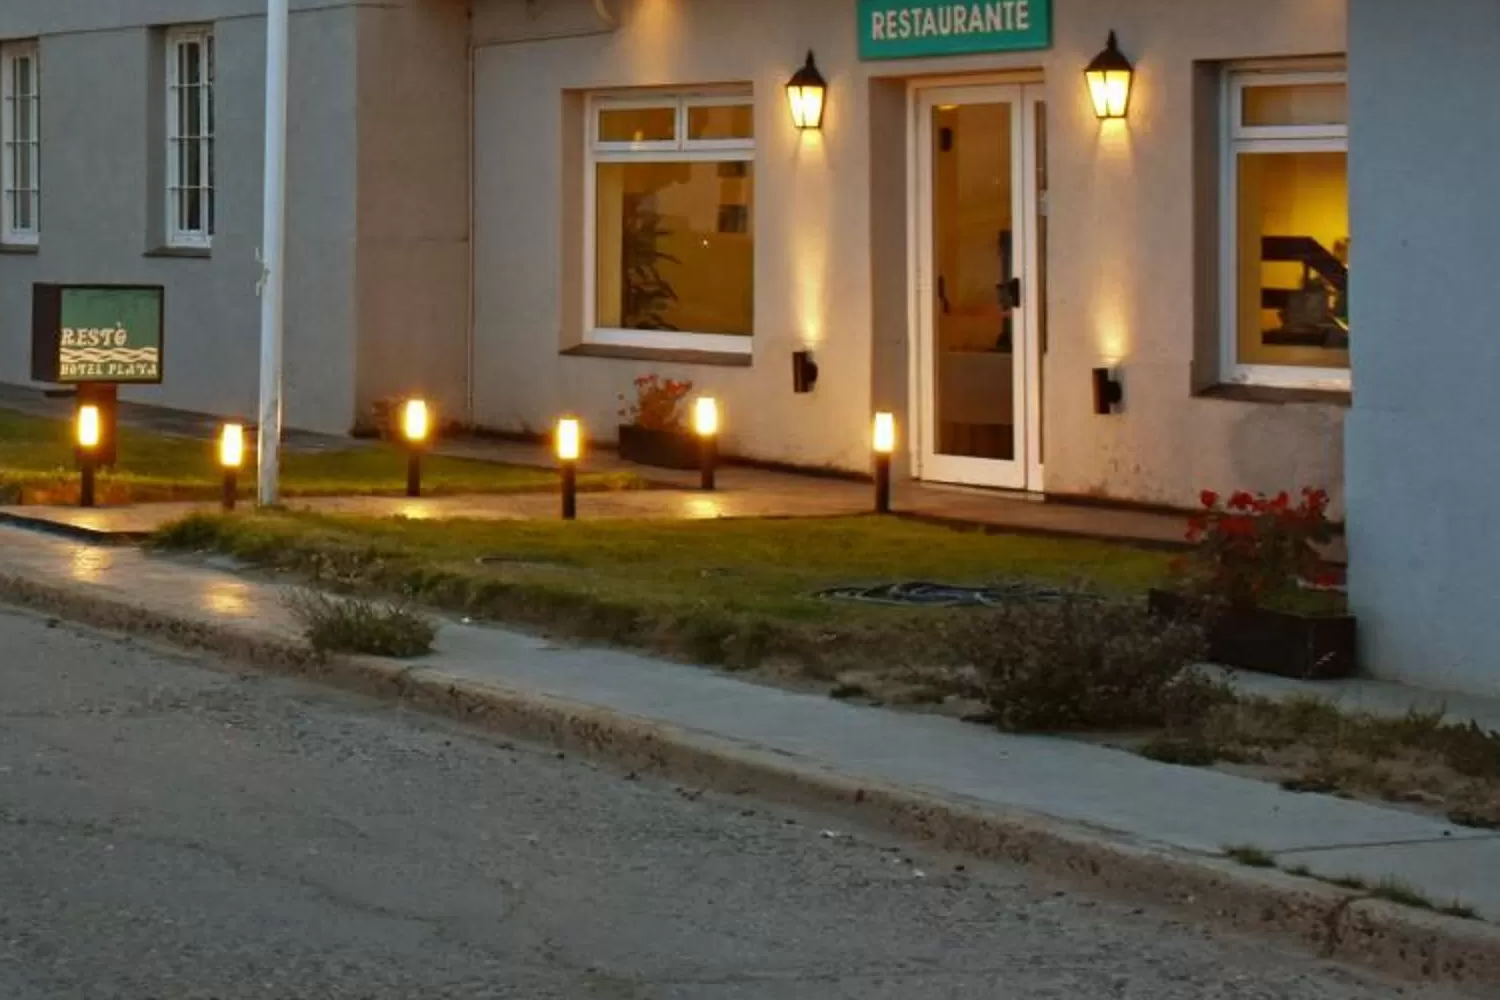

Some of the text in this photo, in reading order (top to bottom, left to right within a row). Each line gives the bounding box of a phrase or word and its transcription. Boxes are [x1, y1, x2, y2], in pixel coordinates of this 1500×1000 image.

[871, 0, 1030, 41] RESTAURANTE
[60, 362, 157, 376] HOTEL PLAYA
